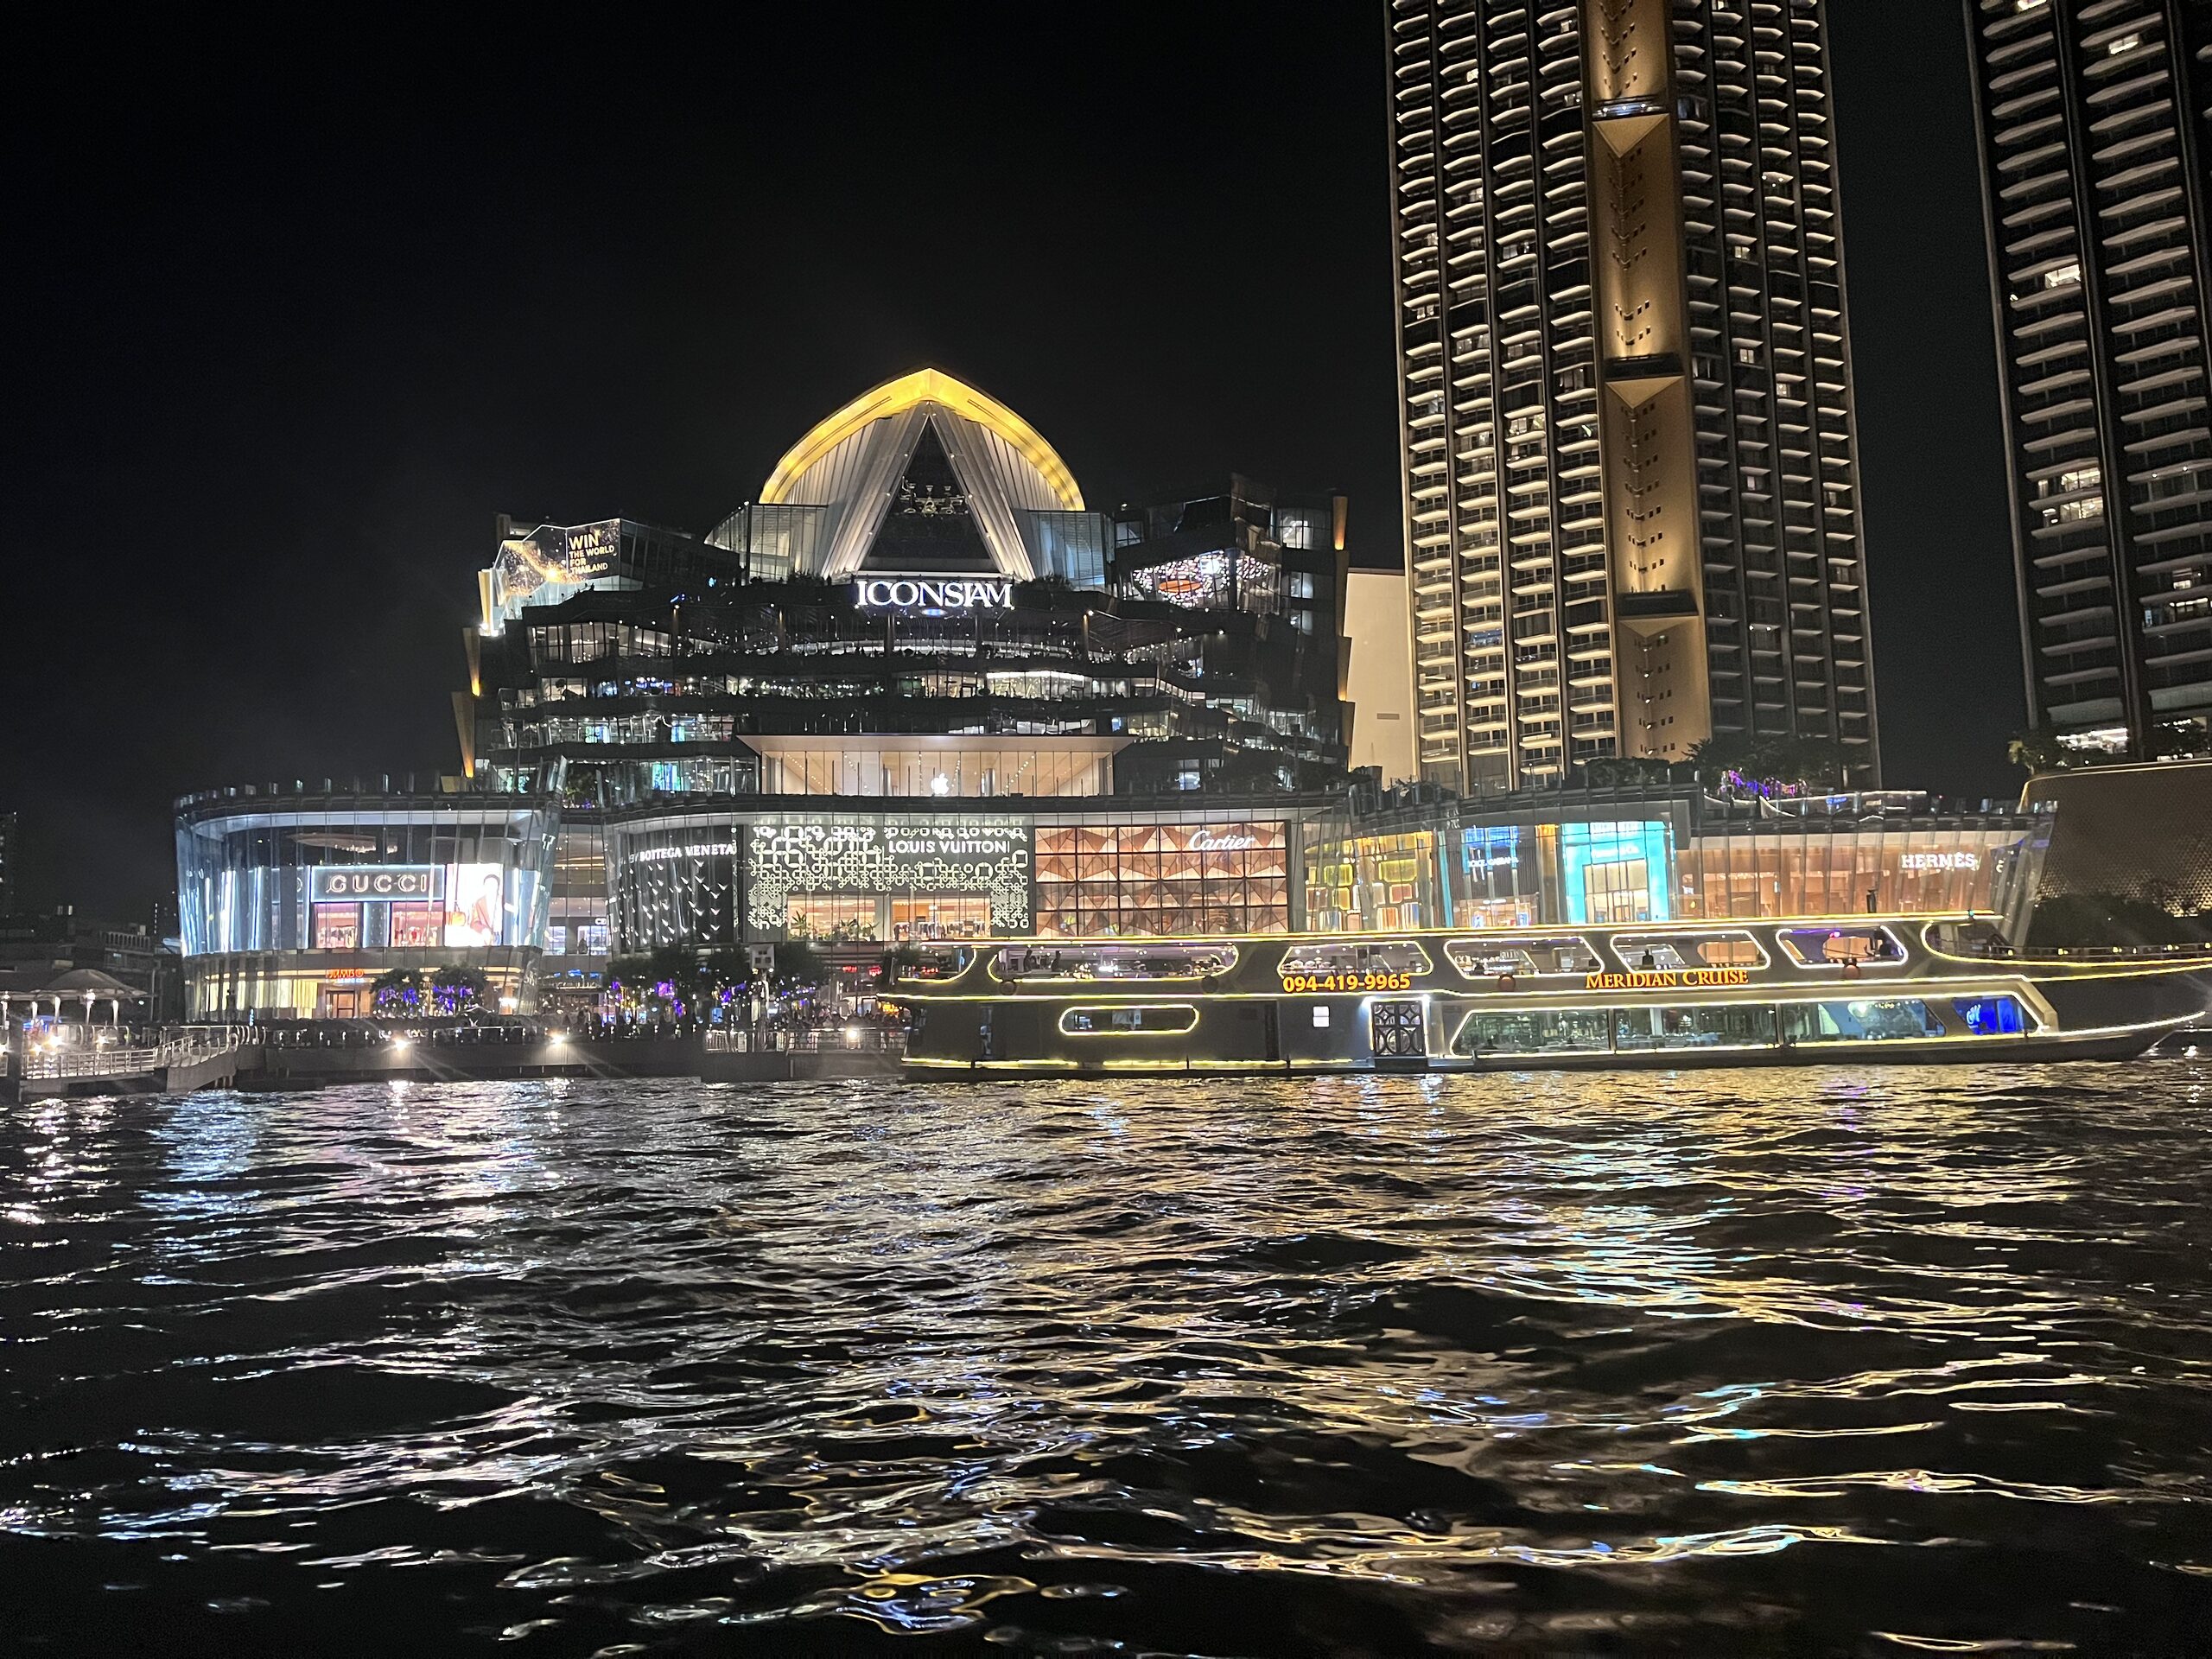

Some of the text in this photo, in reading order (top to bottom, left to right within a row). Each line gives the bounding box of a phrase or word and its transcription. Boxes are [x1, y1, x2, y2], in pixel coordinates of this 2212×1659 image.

[569, 532, 600, 550] WIN
[569, 545, 615, 559] THE WORLD
[570, 558, 587, 567] FOR
[570, 563, 608, 575] THAILAND
[857, 581, 1013, 607] ICONSIAM
[888, 840, 1007, 854] LOUIS VUITTON
[1189, 830, 1255, 851] Cartier
[639, 847, 683, 862] BOTTEGA
[684, 843, 734, 856] VENETA
[329, 874, 428, 893] GUCCI
[1282, 974, 1411, 993] 094-419-9965
[1586, 970, 1749, 988] MERIDIAN CRUISE
